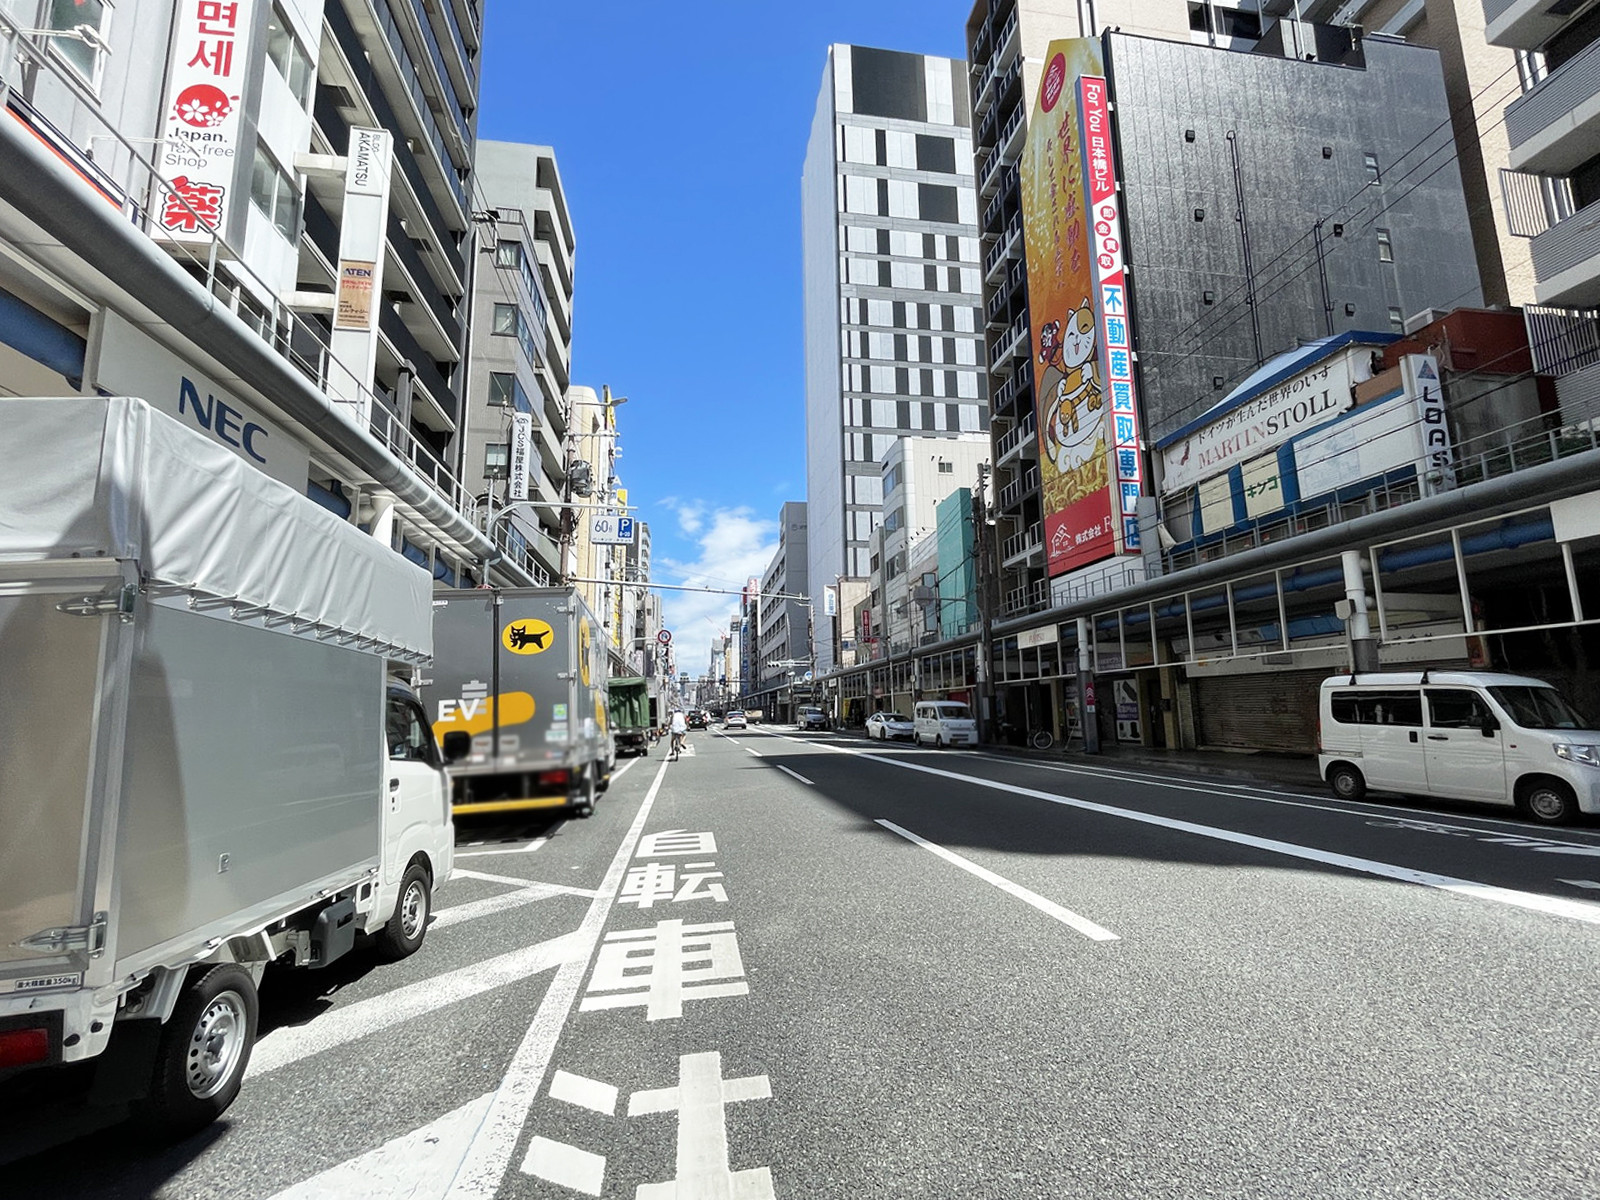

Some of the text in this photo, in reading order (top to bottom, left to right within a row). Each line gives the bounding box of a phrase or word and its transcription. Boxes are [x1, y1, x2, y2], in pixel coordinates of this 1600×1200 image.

[187, 1, 238, 77] 면세
[165, 153, 207, 170] Shop
[168, 127, 227, 143] Japan.
[354, 132, 371, 187] AKAMATSU
[1087, 84, 1110, 192] For You 日本橋ビル
[162, 176, 221, 230] 薬
[345, 268, 372, 277] ATEN
[179, 376, 269, 464] NEC
[1104, 287, 1141, 546] 不動産買取専門店
[1198, 364, 1331, 445] ドイツが生んだ世界のいす
[1198, 389, 1337, 470] MARTINSTOLL
[1423, 385, 1449, 468] LOAS
[1075, 524, 1102, 545] 株式会社
[438, 699, 480, 722] EV
